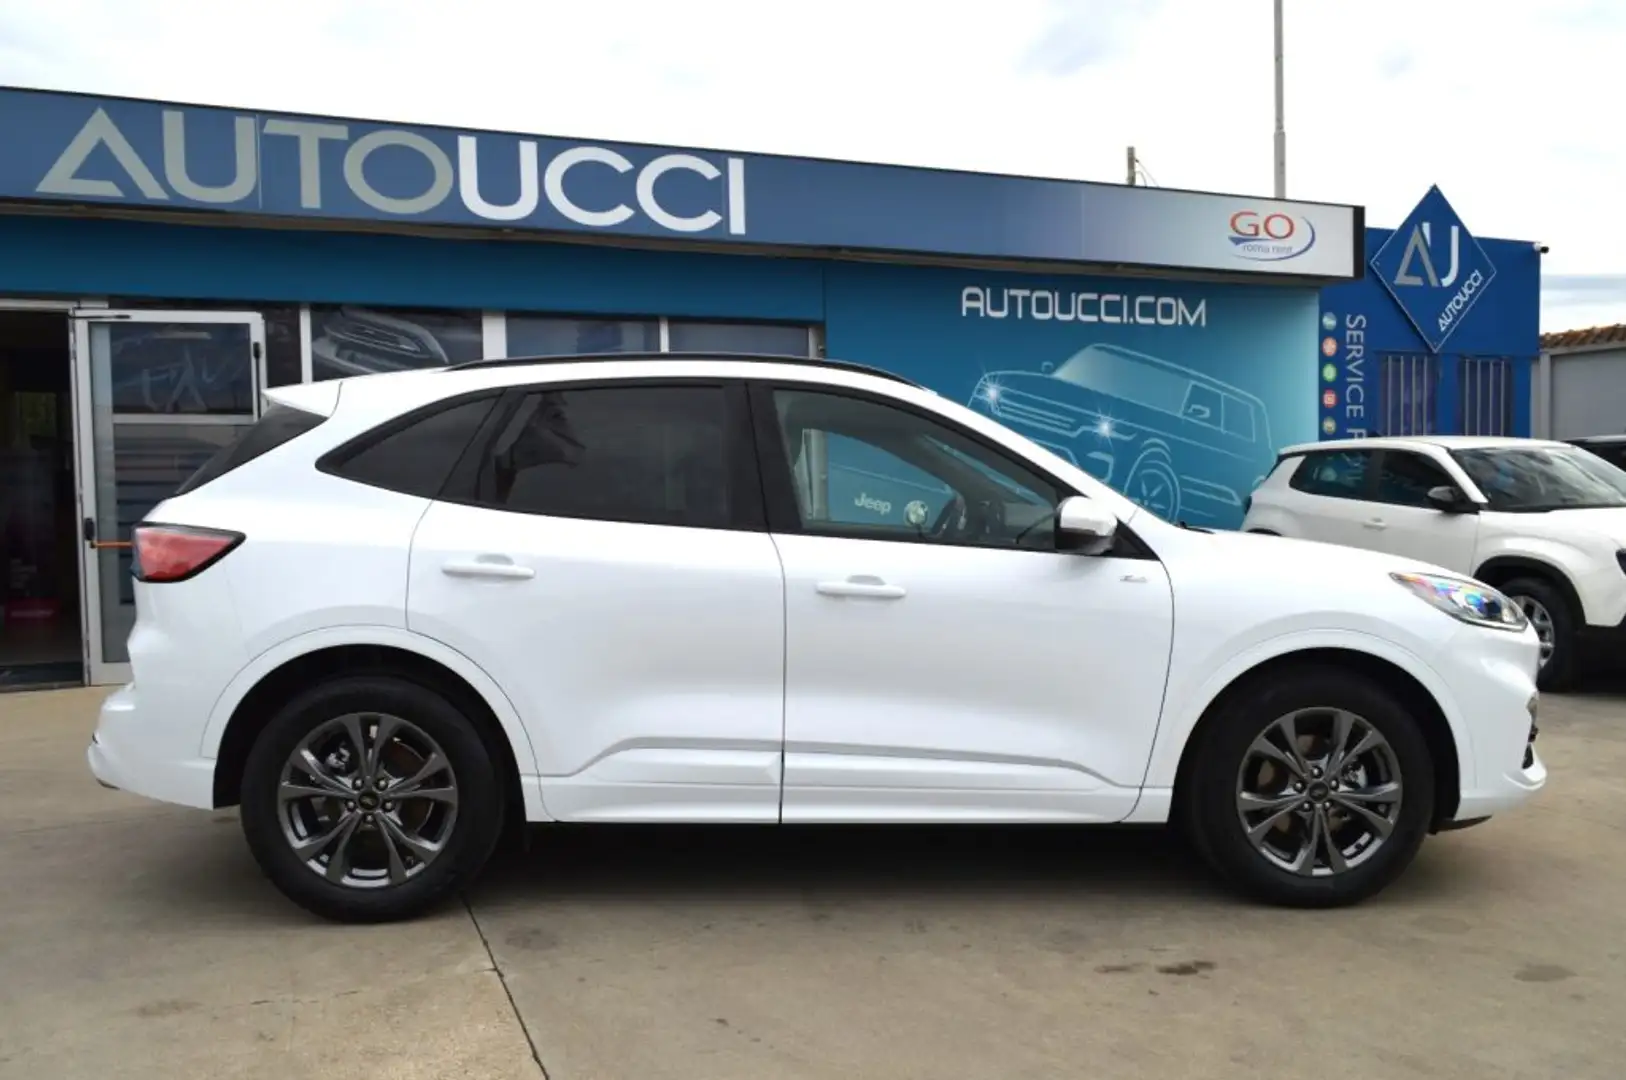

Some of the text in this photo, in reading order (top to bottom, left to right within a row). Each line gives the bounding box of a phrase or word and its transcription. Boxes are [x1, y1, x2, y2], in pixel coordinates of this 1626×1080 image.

[36, 107, 747, 235] AUTOUCCI
[1230, 211, 1295, 239] GO
[961, 286, 1206, 327] AUTOUCCI.COM
[1437, 269, 1484, 332] AUTOUCCI
[1345, 313, 1367, 419] SERVICE
[854, 492, 892, 516] Jeep
